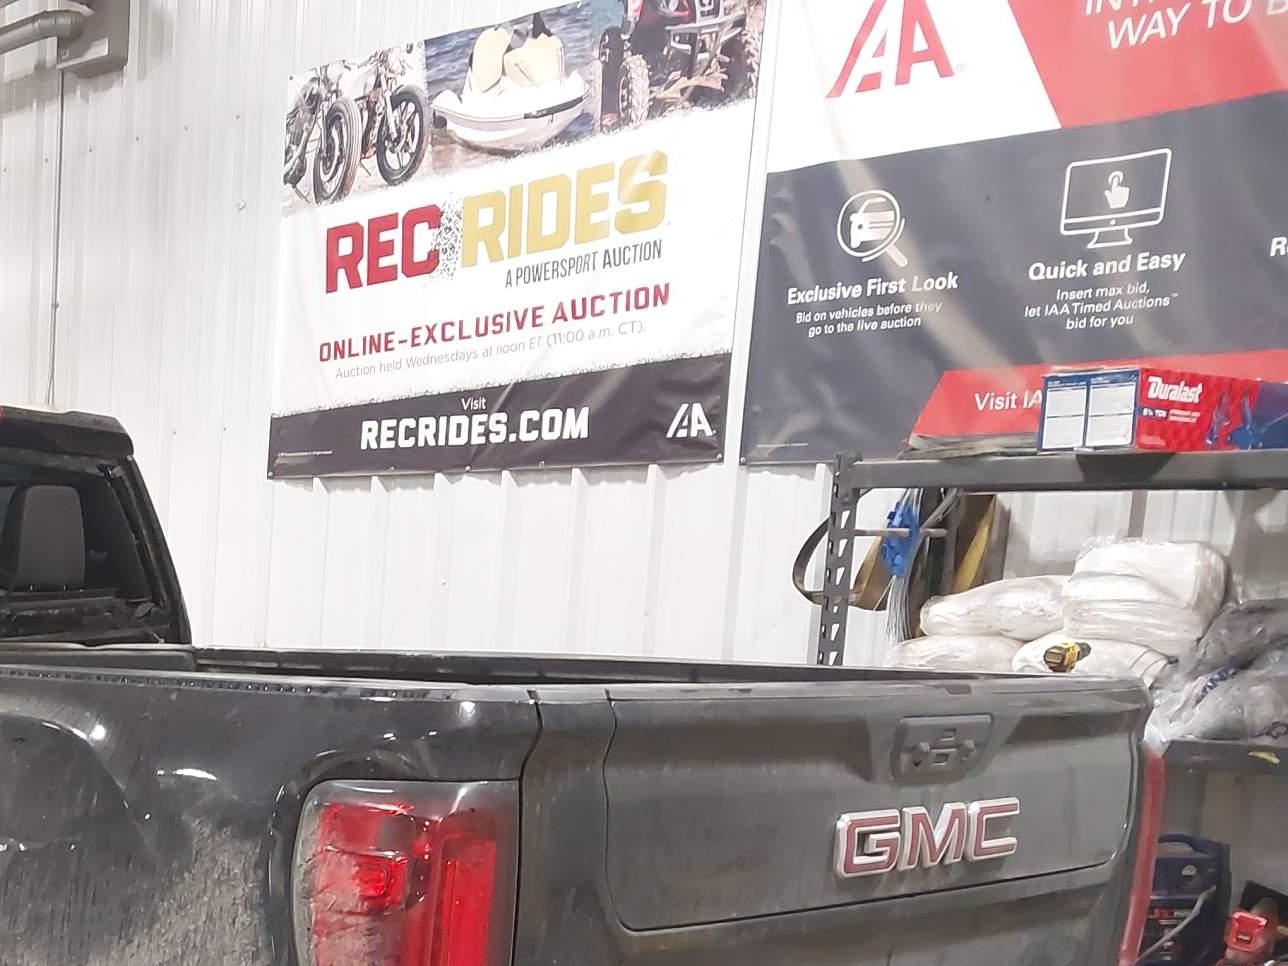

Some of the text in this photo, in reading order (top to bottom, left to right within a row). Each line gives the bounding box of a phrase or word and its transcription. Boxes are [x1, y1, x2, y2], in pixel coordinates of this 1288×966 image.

[1107, 2, 1192, 49] WAY
[326, 151, 668, 294] REC RIDES
[1270, 236, 1288, 256] R
[505, 239, 663, 288] A POWERSPORT AUCTION
[1028, 252, 1186, 280] Quick and Easy
[787, 271, 960, 304] Exclusive First Look
[1056, 281, 1150, 301] Insert max bid,
[319, 283, 671, 362] ONLINE-EXCLUSIVE AUCTION
[796, 301, 943, 324] Bid on vehicles before they
[1024, 306, 1041, 318] let
[1044, 303, 1070, 316] IAA
[1072, 300, 1111, 314] Timed
[1065, 316, 1134, 330] bid for you
[808, 317, 922, 338] go to the live auction
[334, 360, 376, 380] Auction
[379, 357, 402, 374] held
[405, 346, 479, 369] Wednesdays
[481, 344, 493, 358] at
[496, 341, 526, 355] noon
[528, 335, 543, 349] ET
[546, 329, 585, 348] (11:00
[460, 396, 488, 411] Visit
[974, 389, 1043, 411] Visit IA
[1147, 376, 1203, 404] Duralast
[360, 407, 590, 451] RECRIDES.COM
[834, 797, 1020, 878] GMC
